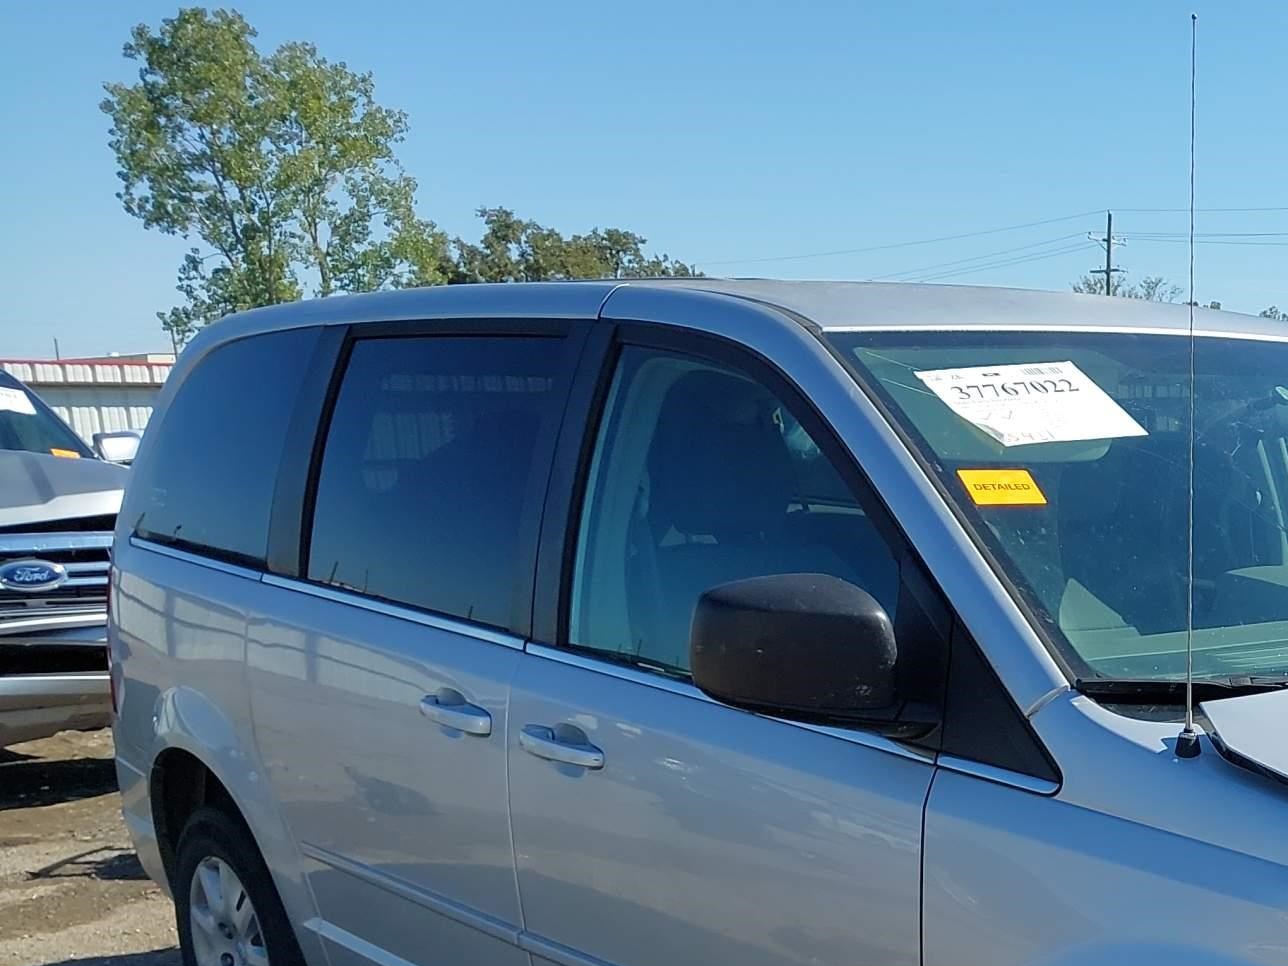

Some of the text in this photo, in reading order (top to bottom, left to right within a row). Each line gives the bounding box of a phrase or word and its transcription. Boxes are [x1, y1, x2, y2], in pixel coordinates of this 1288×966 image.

[950, 379, 1080, 400] 37767022
[973, 483, 1030, 491] DETAILED
[14, 567, 49, 582] Ford
